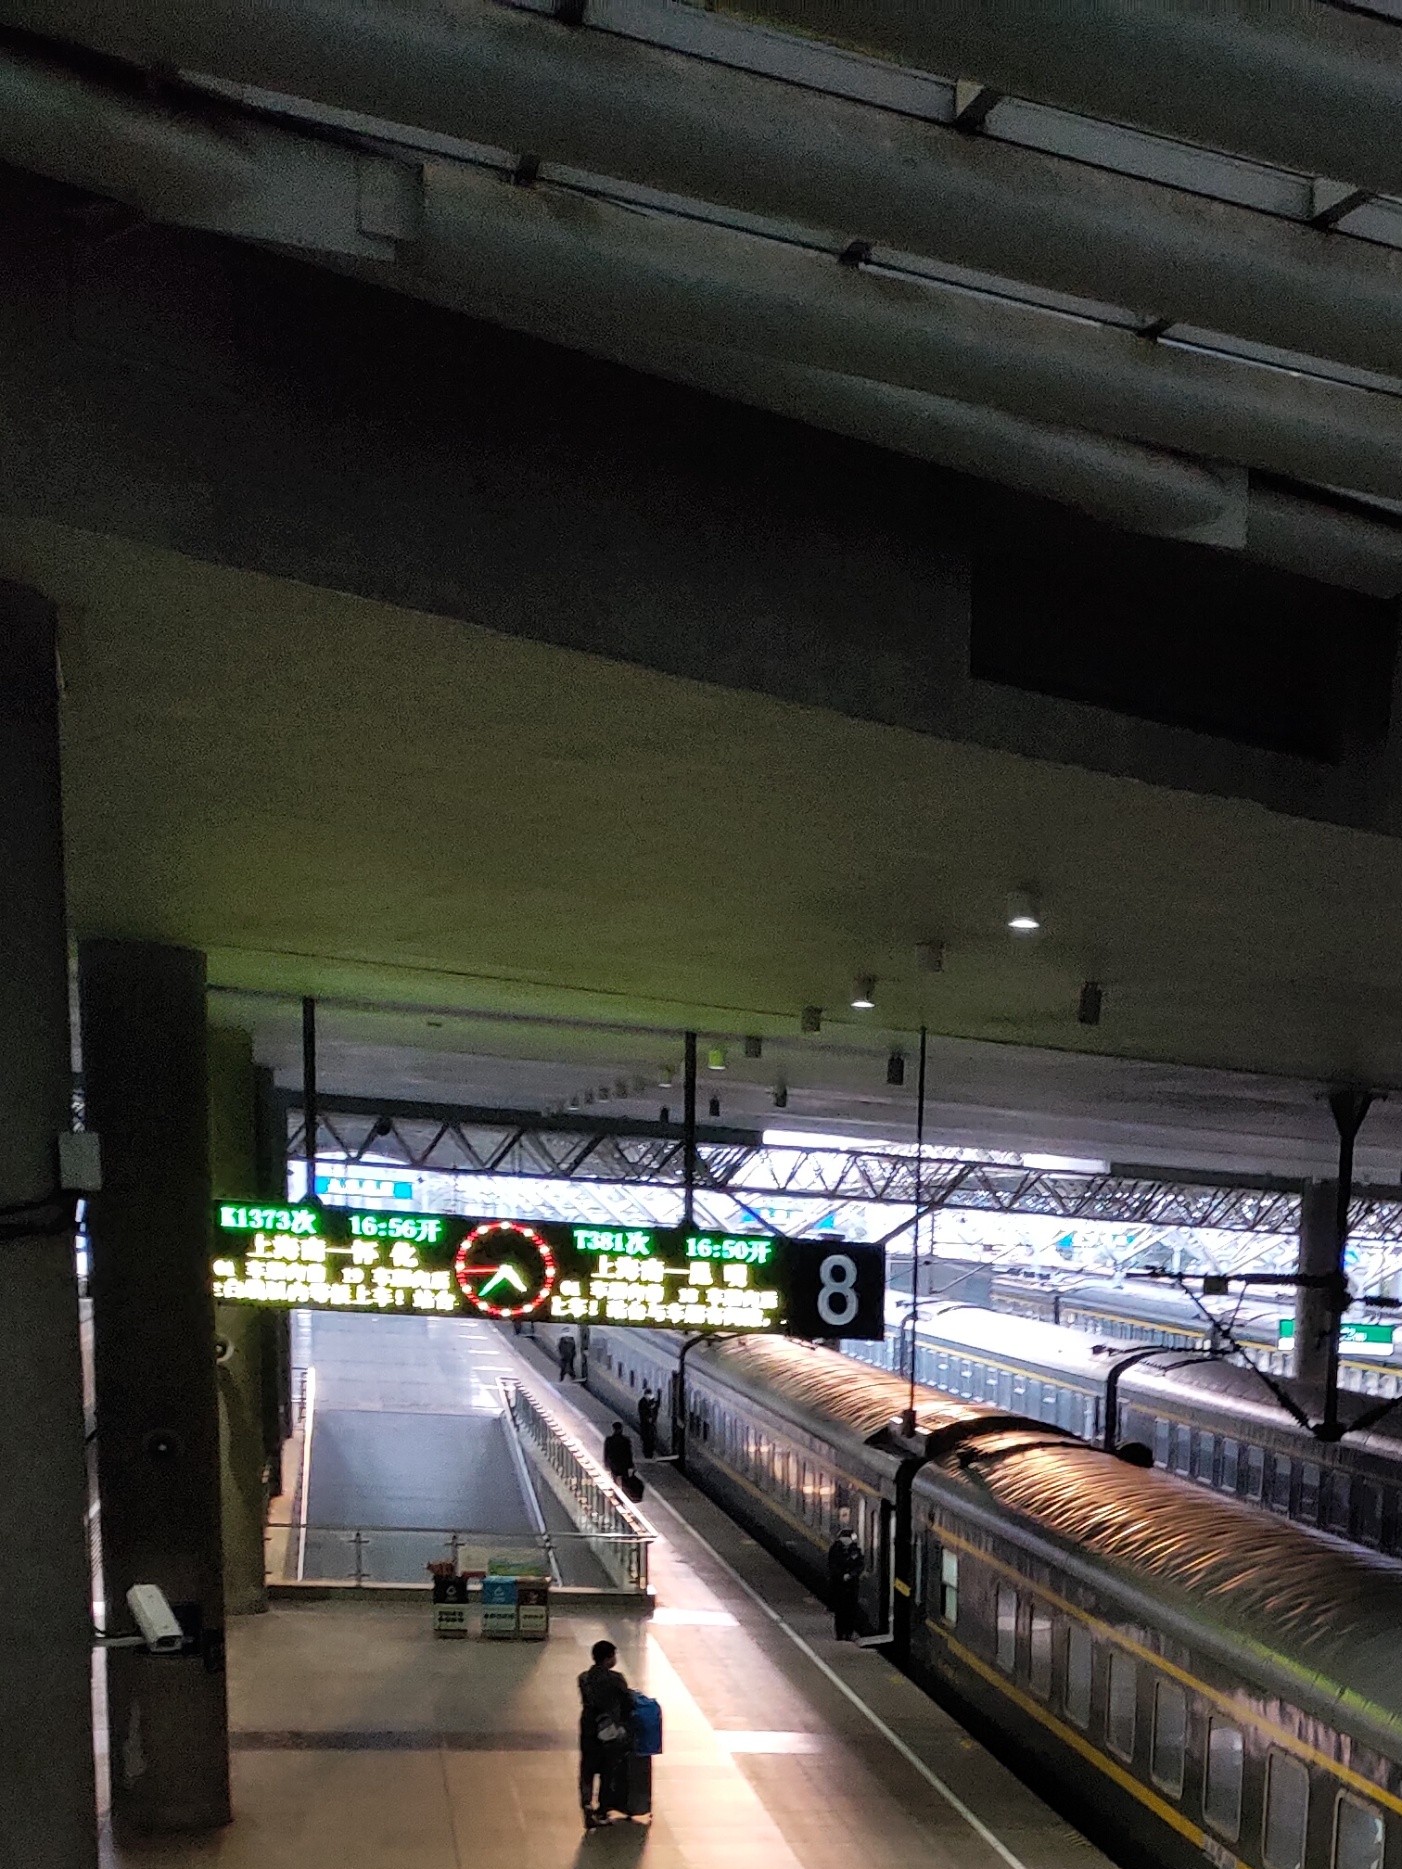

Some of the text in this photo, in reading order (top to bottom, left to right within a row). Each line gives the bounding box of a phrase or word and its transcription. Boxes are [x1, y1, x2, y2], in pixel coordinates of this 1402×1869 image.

[219, 1206, 442, 1243] K1373次 16:56开
[573, 1230, 772, 1264] T381次 16:50开
[817, 1253, 859, 1326] 8
